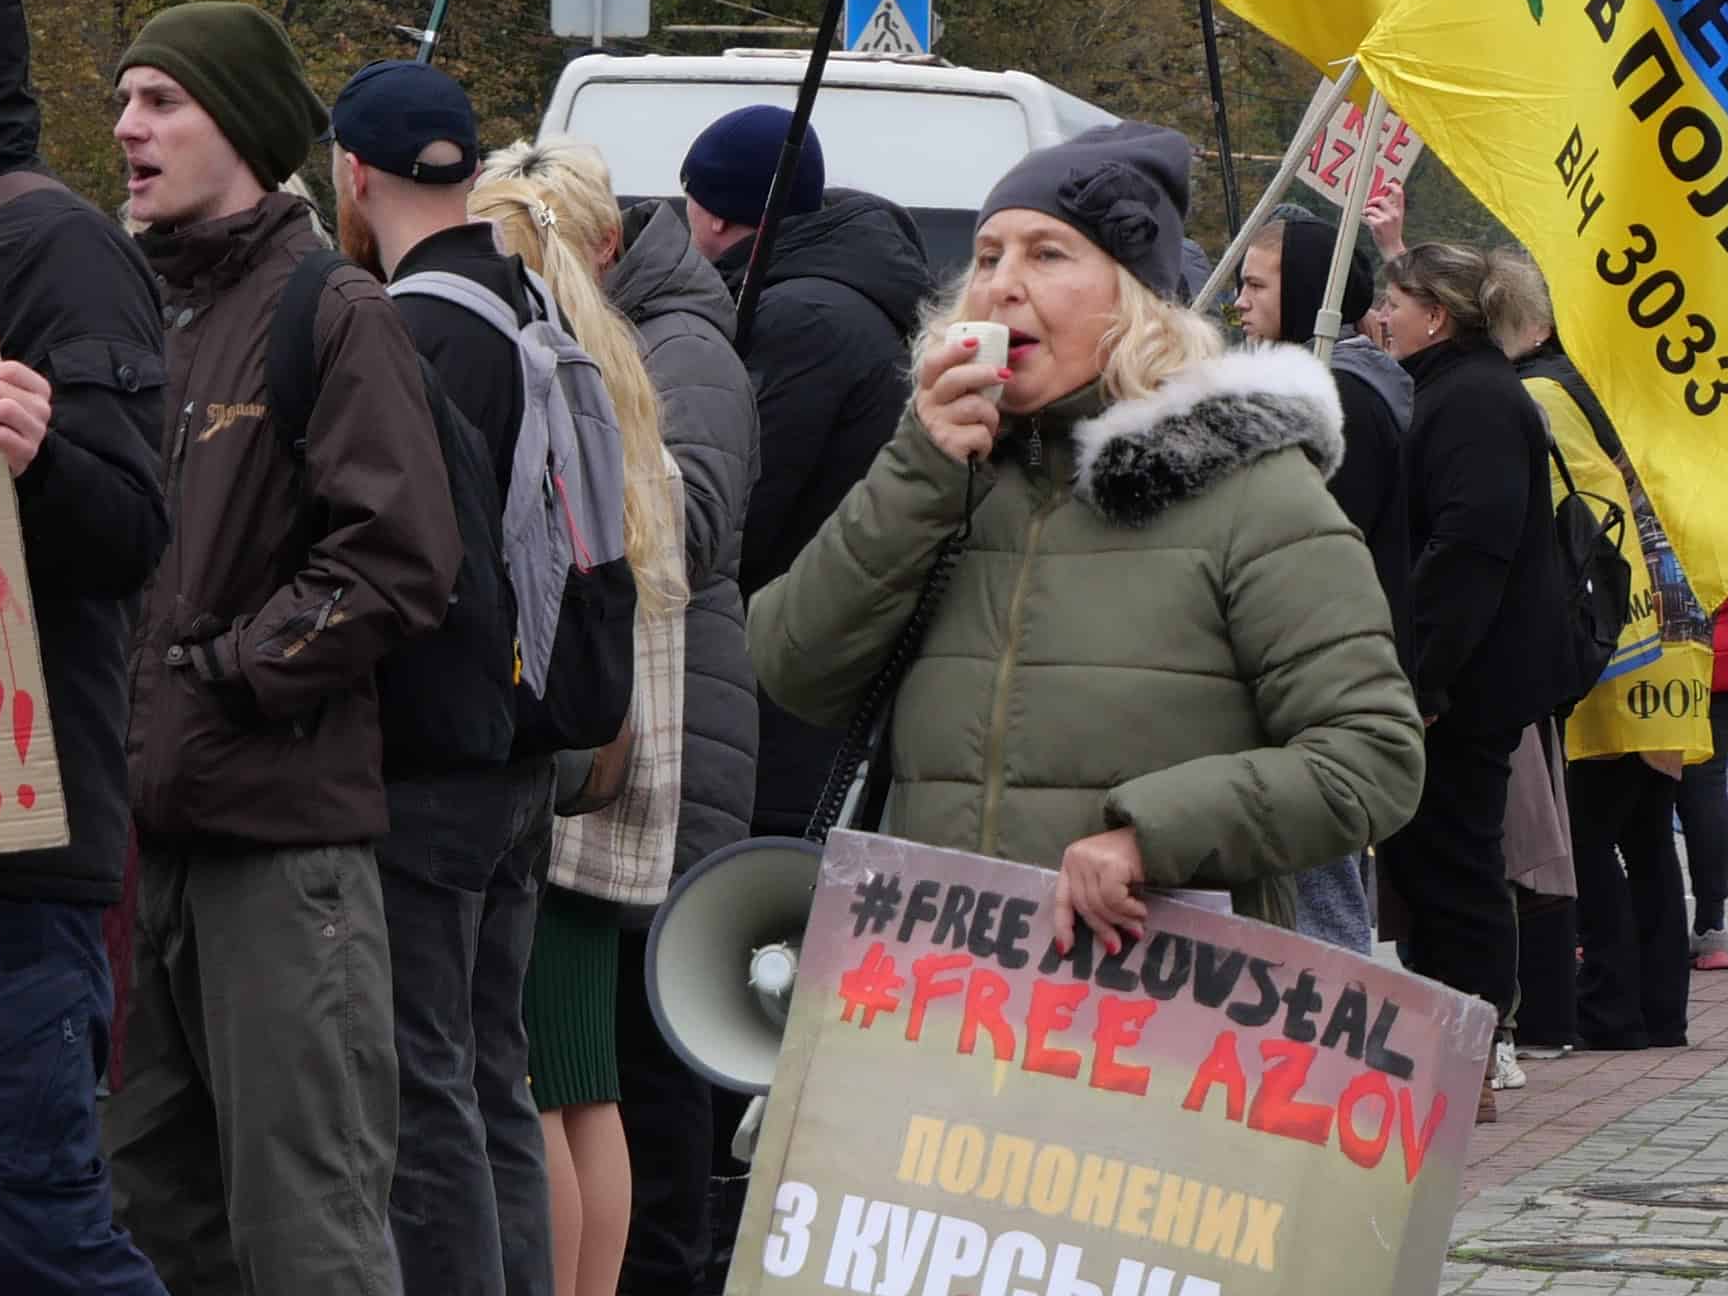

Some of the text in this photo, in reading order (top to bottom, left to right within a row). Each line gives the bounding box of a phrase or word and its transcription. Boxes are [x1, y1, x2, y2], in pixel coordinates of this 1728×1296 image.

[1627, 678, 1712, 720] ФОР
[852, 873, 1039, 970] #FREE
[838, 941, 1448, 1186] #FREE AZOV
[897, 1114, 1284, 1272] ПОЛОНЕНИХ
